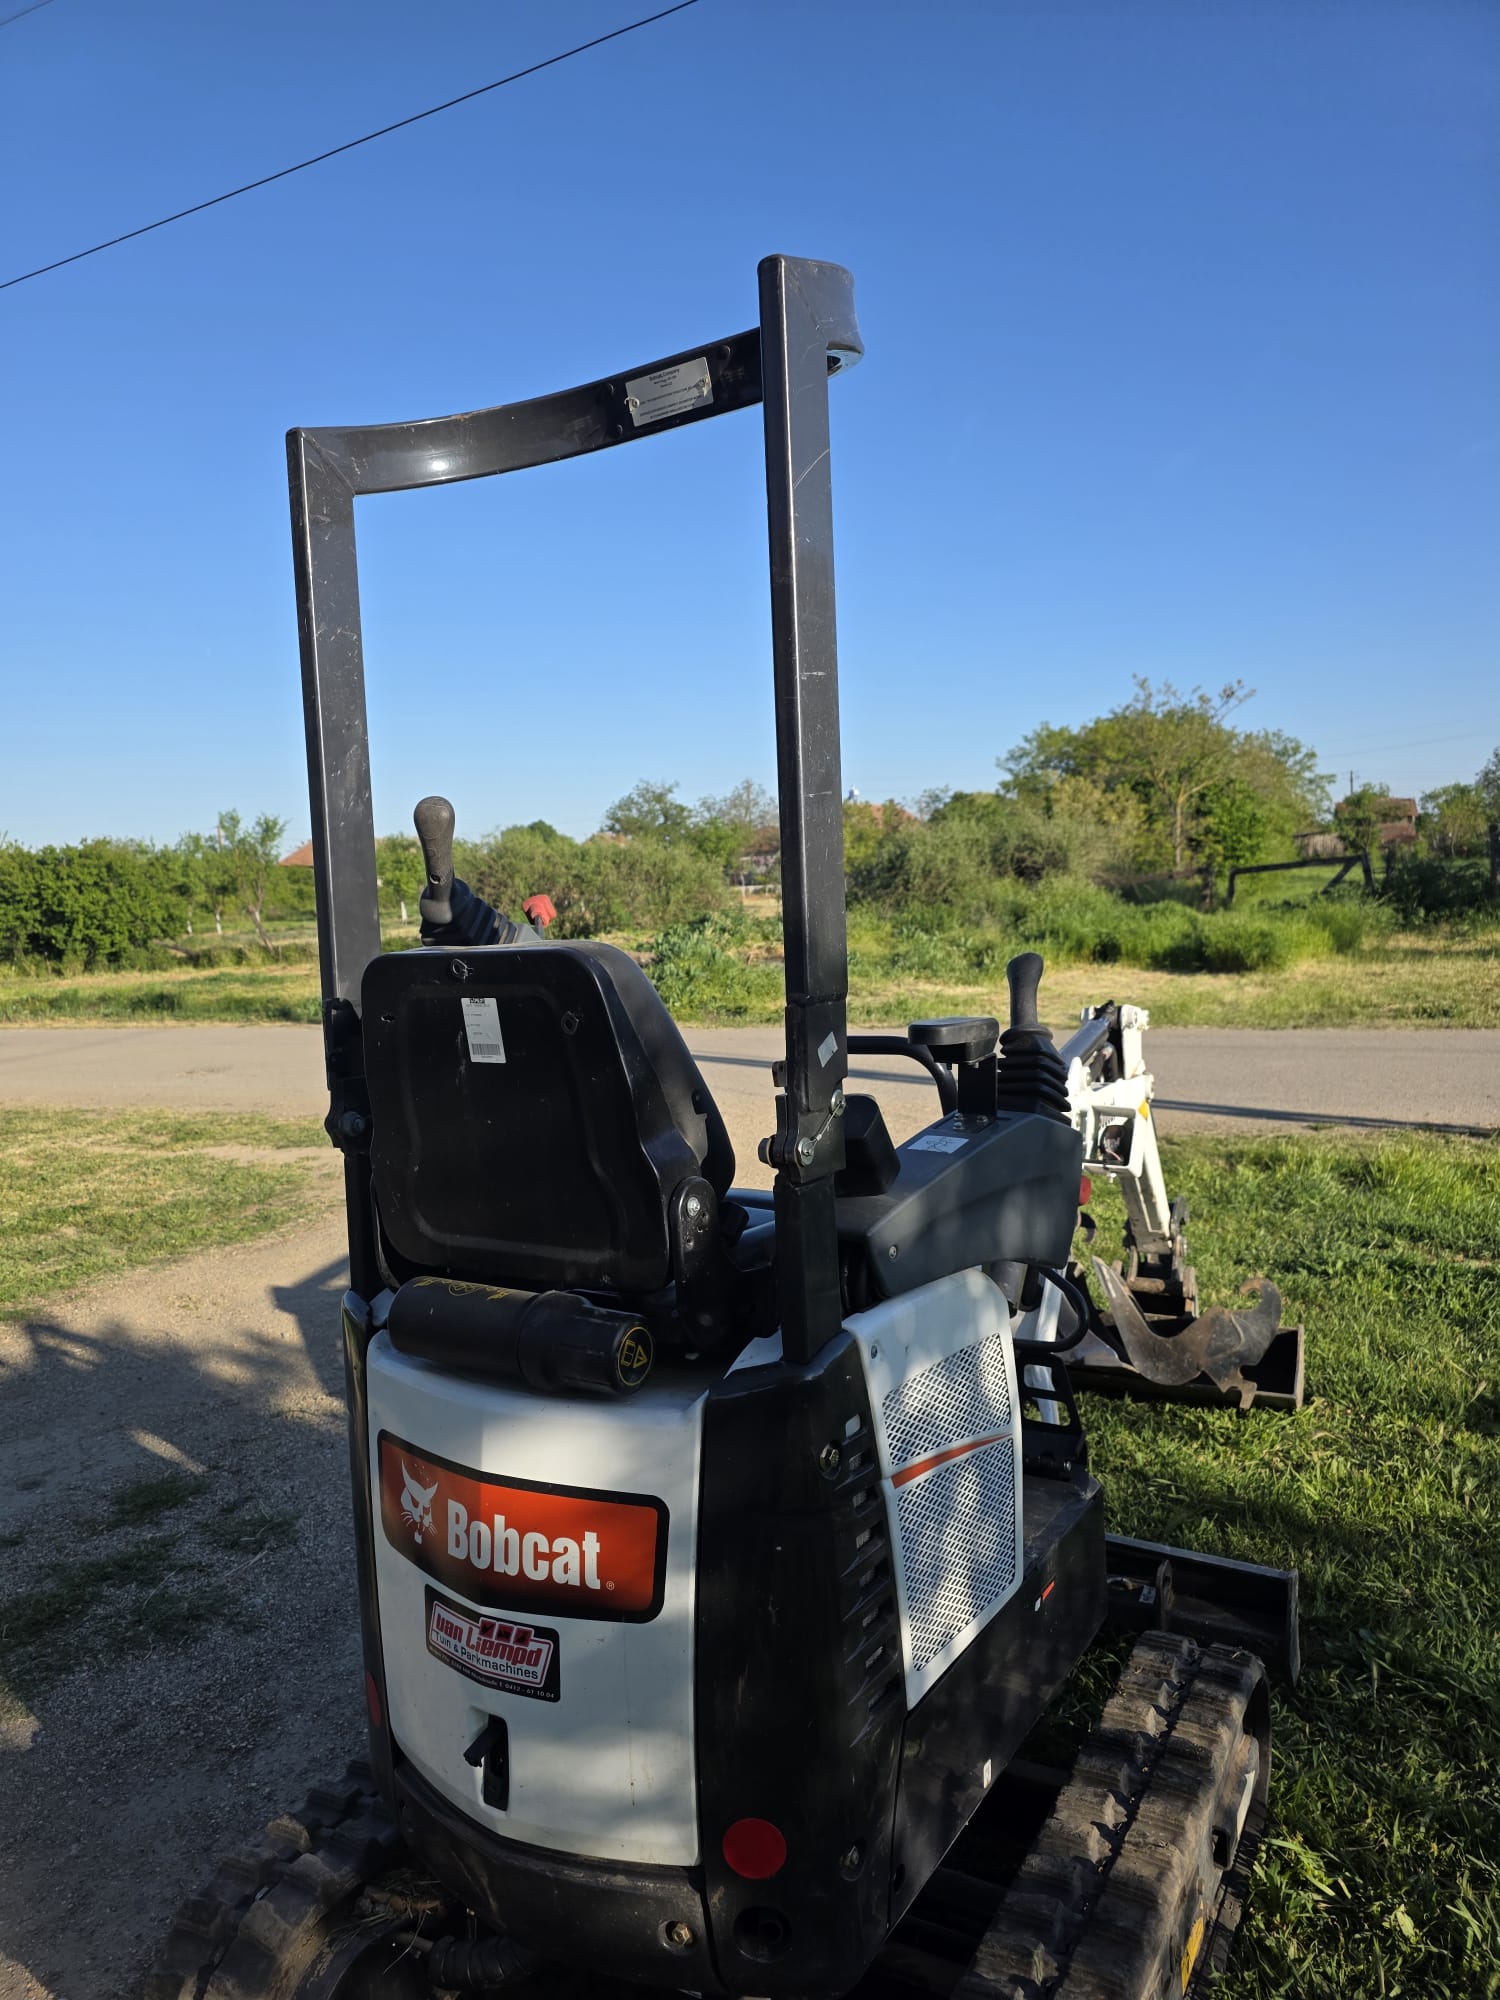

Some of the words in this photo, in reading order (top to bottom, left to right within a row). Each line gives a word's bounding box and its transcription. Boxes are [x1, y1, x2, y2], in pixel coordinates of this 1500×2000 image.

[448, 1499, 600, 1589] Bobcat
[432, 1630, 452, 1647] Tuin
[453, 1643, 459, 1653] &
[461, 1647, 539, 1679] Parkmachines
[466, 1626, 543, 1668] Liempd
